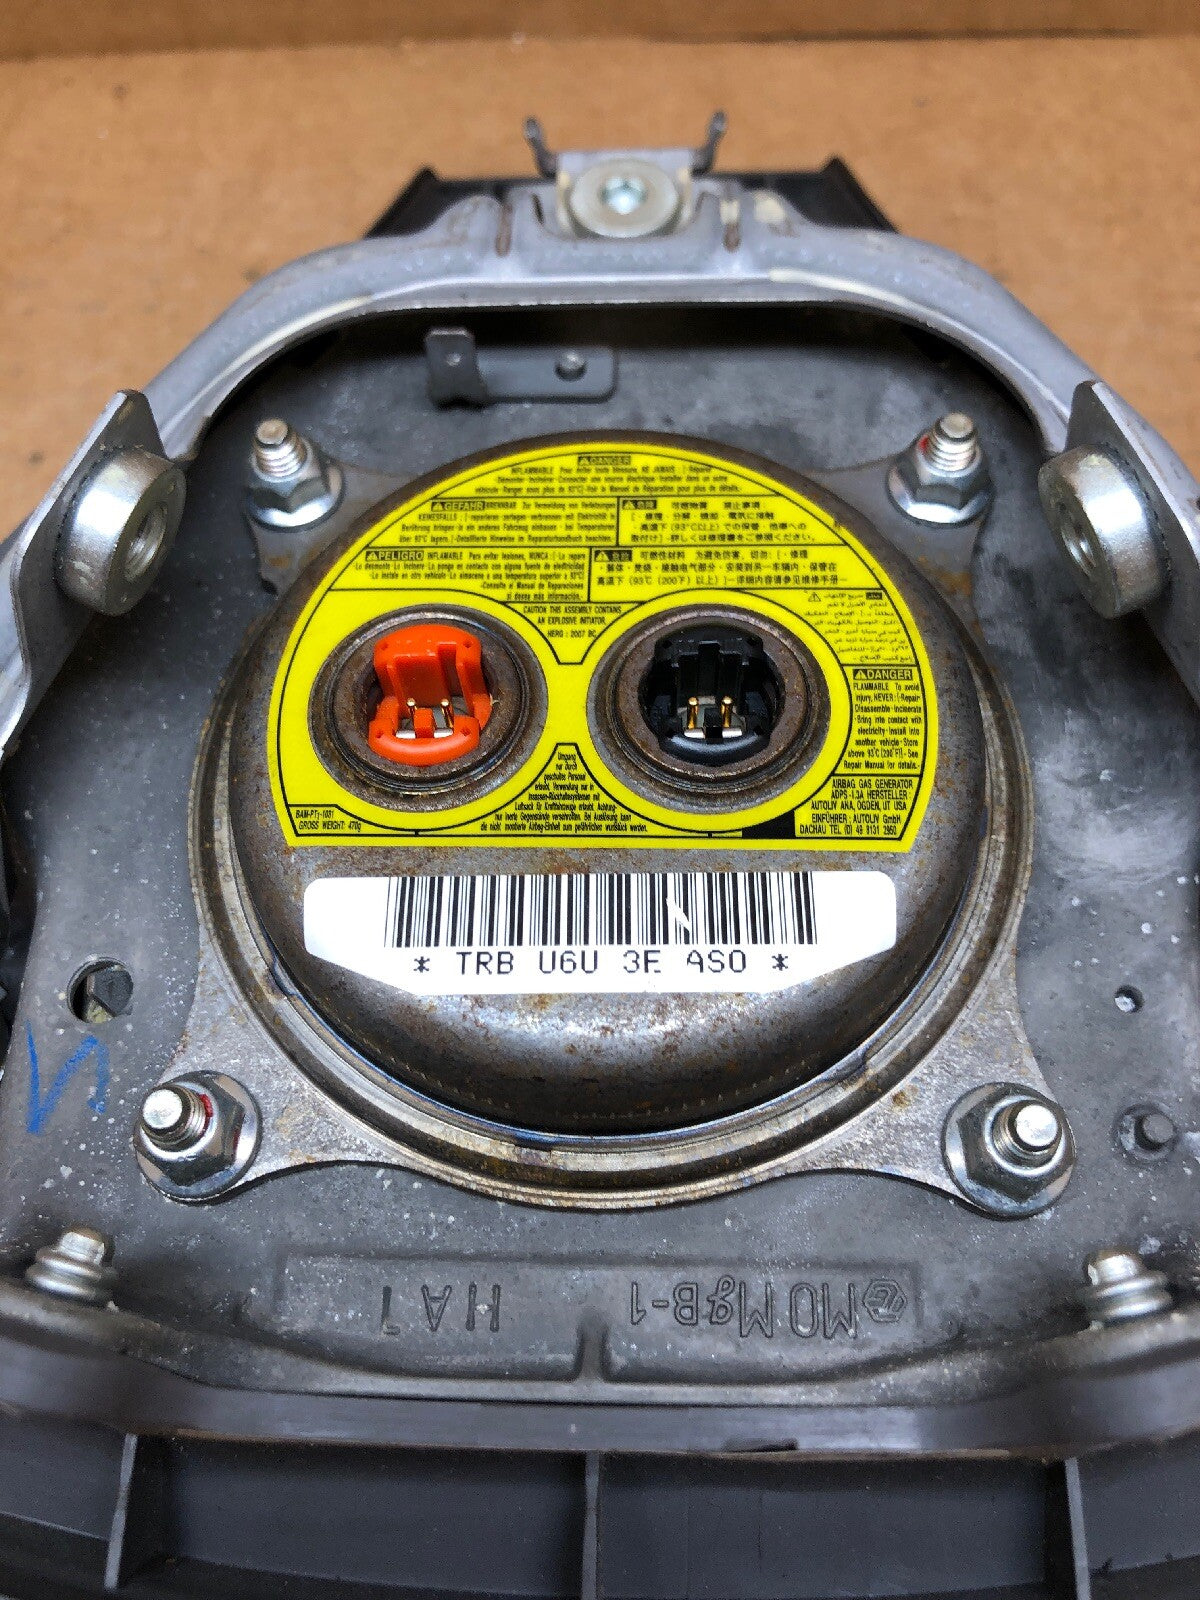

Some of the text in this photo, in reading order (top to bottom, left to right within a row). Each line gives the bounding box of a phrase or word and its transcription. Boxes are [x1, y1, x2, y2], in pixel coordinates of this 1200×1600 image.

[445, 502, 485, 510] GEFAHR
[379, 551, 423, 561] PELIGRO
[867, 669, 912, 680] DANGER
[888, 715, 908, 723] contact
[844, 760, 862, 771] Repair
[865, 760, 884, 769] Manual
[887, 760, 895, 769] for
[832, 779, 913, 788] AIRBAG GAS GENERATOR
[811, 801, 837, 810] AUTOLIV
[883, 801, 890, 810] UT
[894, 801, 906, 810] USA
[853, 814, 879, 823] AUTOLIV
[883, 814, 901, 823] GmbH
[299, 821, 319, 830] GROSS
[800, 825, 826, 834] DACHAU
[456, 951, 514, 975] TRB
[539, 950, 598, 974] U6U
